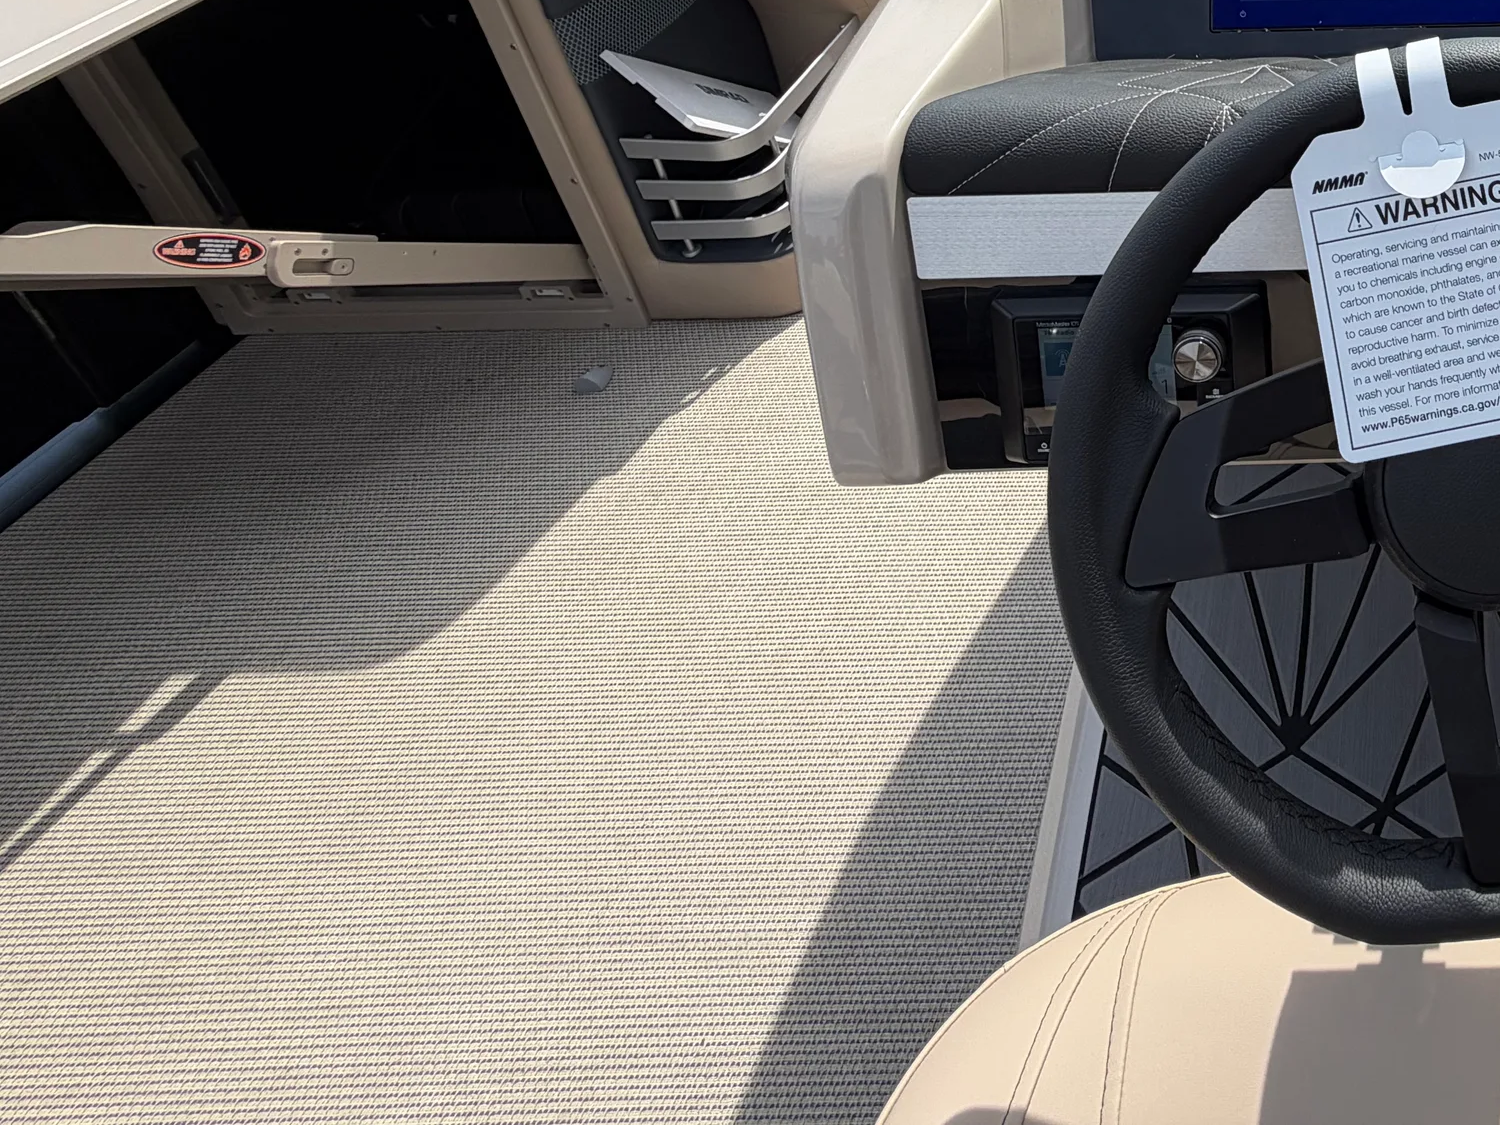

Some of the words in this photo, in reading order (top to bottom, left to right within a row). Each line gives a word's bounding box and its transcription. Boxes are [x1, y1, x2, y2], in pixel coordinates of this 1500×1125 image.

[1312, 172, 1366, 195] NMMA
[1331, 248, 1383, 264] Operating,
[1385, 238, 1428, 253] servicing
[1430, 232, 1449, 244] and
[1334, 271, 1342, 279] a
[1343, 258, 1399, 277] recreational
[1401, 252, 1435, 265] marine
[1436, 245, 1468, 258] vessel
[1469, 242, 1488, 252] can
[1336, 284, 1355, 296] you
[1357, 281, 1368, 290] to
[1369, 271, 1418, 288] chemicals
[1420, 262, 1463, 277] including
[1465, 255, 1497, 268] engine
[1340, 295, 1375, 309] carbon
[1377, 285, 1428, 302] monoxide,
[1430, 274, 1484, 292] phthalates,
[1342, 311, 1372, 324] which
[1374, 308, 1390, 318] are
[1391, 301, 1425, 314] known
[1427, 299, 1438, 308] to
[1440, 295, 1456, 305] the
[1457, 289, 1484, 301] State
[1486, 285, 1496, 296] of
[1345, 331, 1356, 340] to
[1358, 324, 1388, 337] cause
[1390, 317, 1423, 331] cancer
[1426, 311, 1445, 324] and
[1447, 307, 1470, 319] birth
[1348, 336, 1409, 355] reproductive
[1410, 330, 1439, 342] harm.
[1441, 325, 1454, 335] To
[1456, 318, 1499, 333] minimize
[1351, 357, 1377, 371] avoid
[1378, 349, 1423, 365] breathing
[1424, 340, 1465, 356] exhaust,
[1466, 334, 1500, 347] service
[1353, 377, 1363, 386] in
[1364, 376, 1371, 384] a
[1373, 360, 1441, 382] well-ventilated
[1443, 357, 1465, 368] area
[1466, 351, 1486, 363] and
[1355, 389, 1382, 402] wash
[1384, 385, 1405, 398] your
[1407, 378, 1438, 391] hands
[1440, 367, 1487, 385] frequently
[1358, 406, 1377, 418] this
[1378, 399, 1412, 413] vessel.
[1414, 395, 1431, 406] For
[1434, 390, 1460, 402] more
